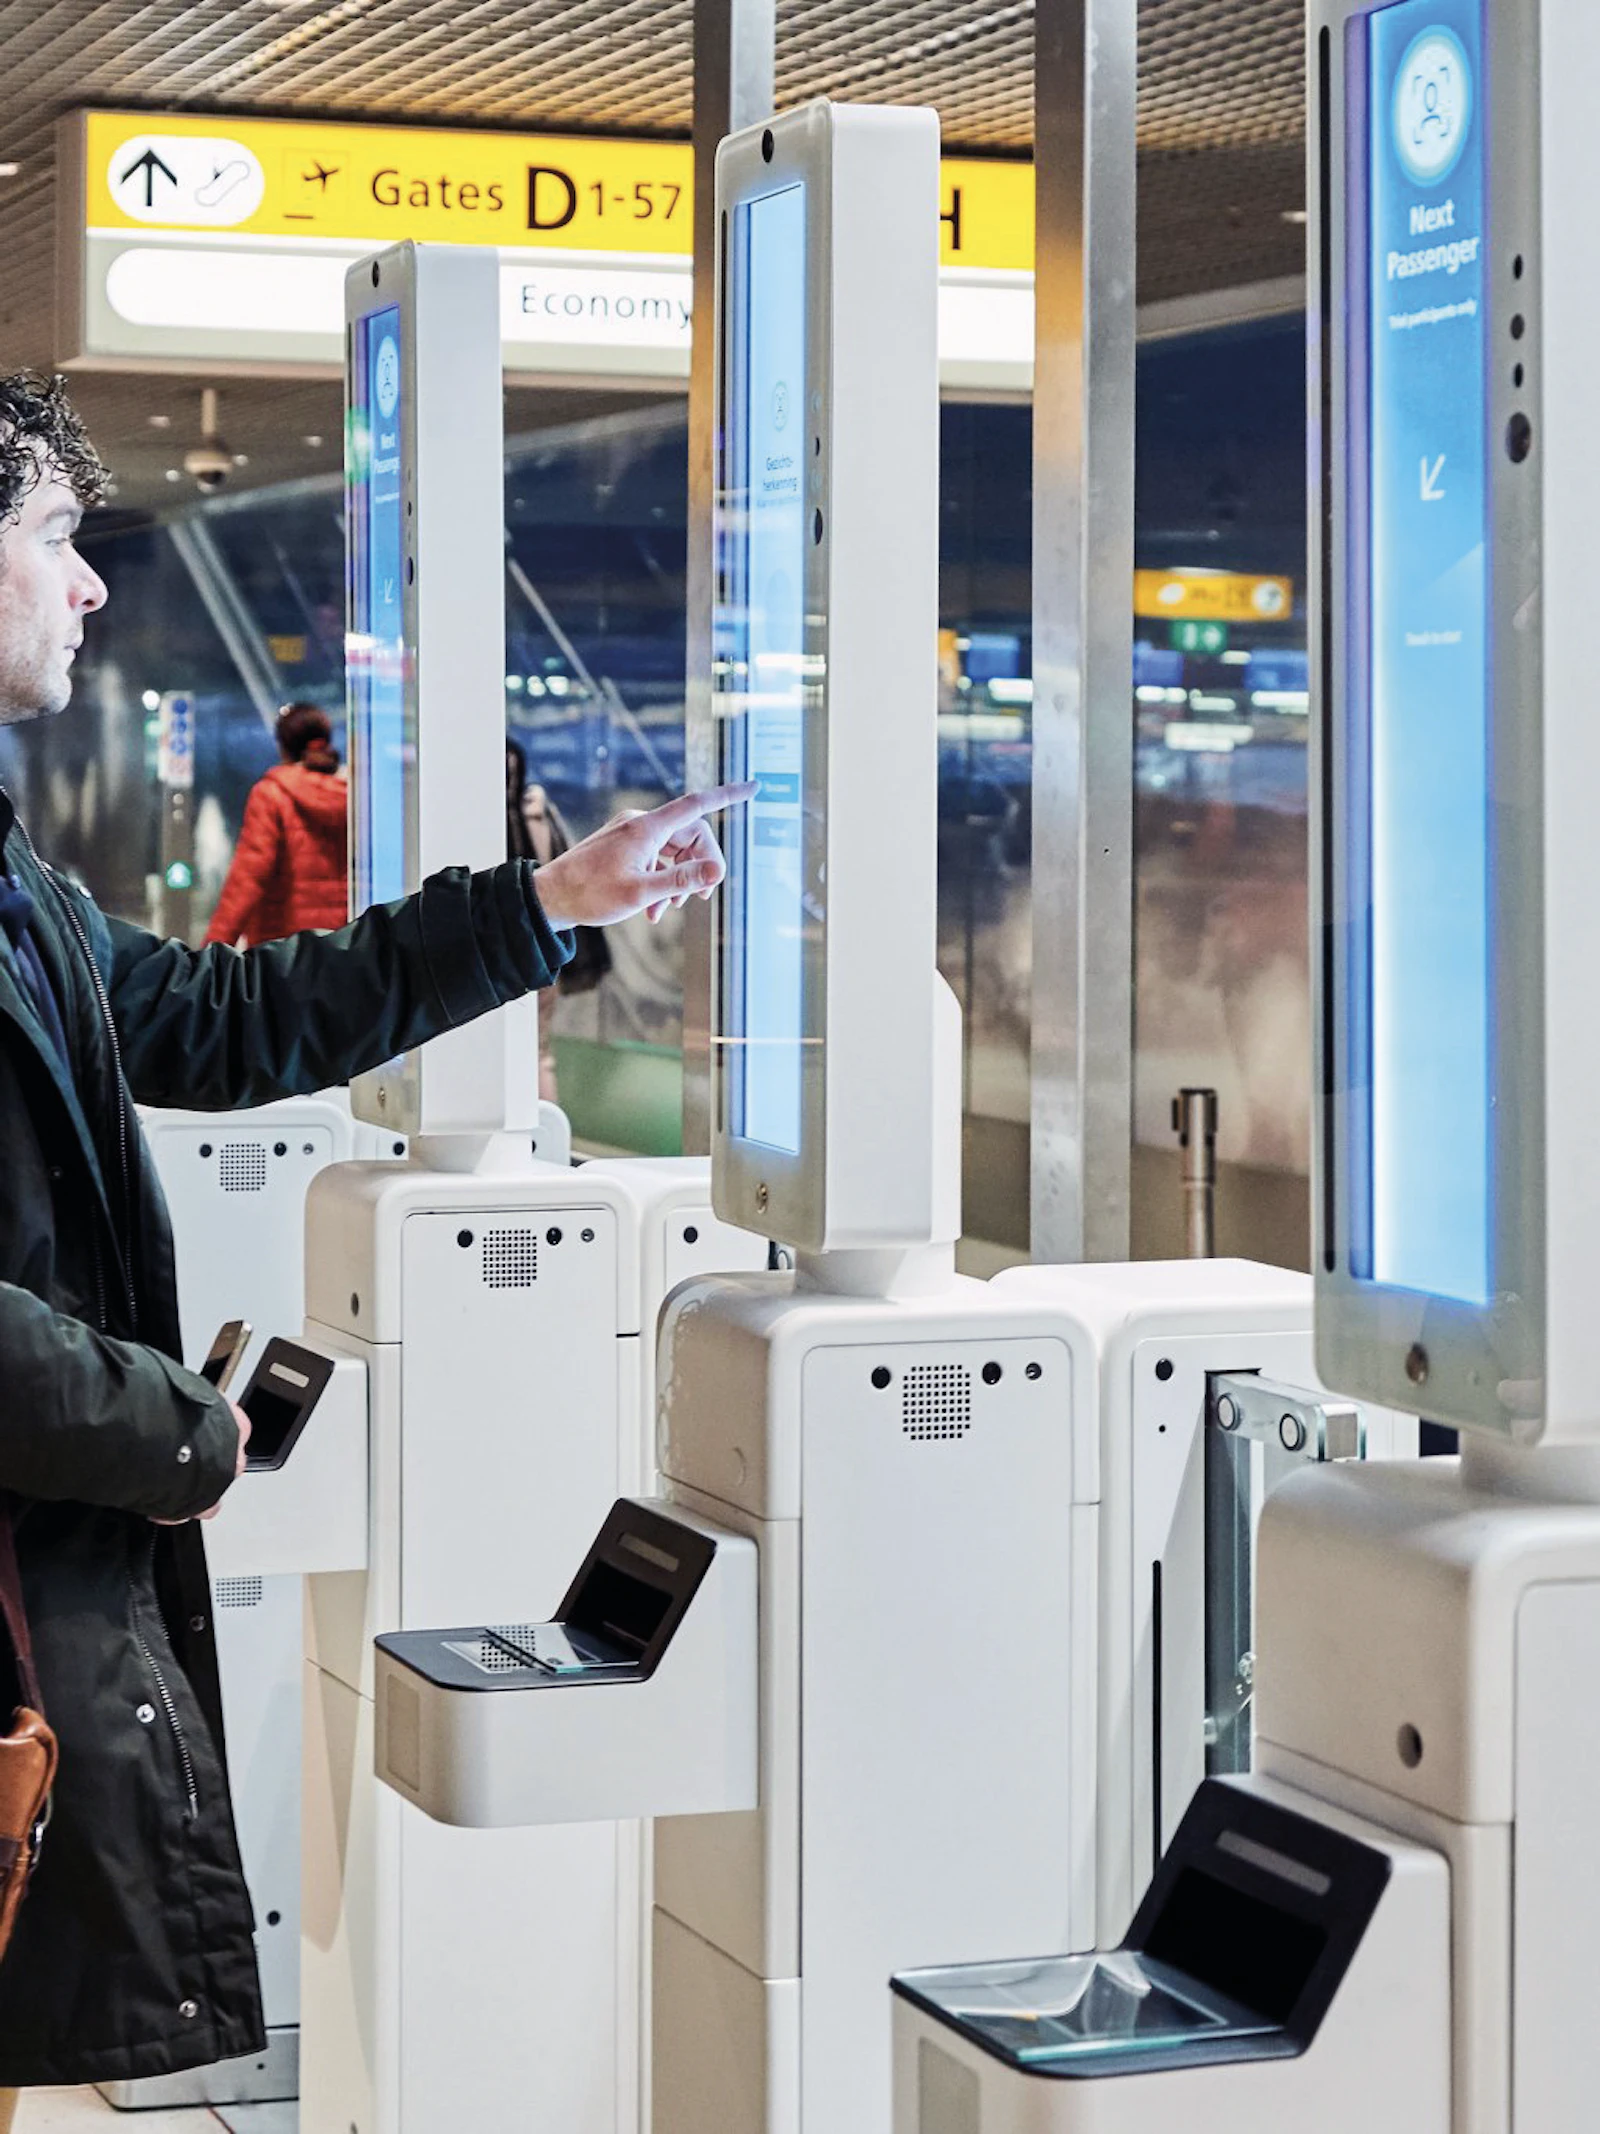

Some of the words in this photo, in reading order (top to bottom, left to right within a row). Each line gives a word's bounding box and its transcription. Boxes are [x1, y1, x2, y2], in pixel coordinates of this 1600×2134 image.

[371, 168, 504, 212] Gates
[527, 165, 578, 230] D
[589, 179, 682, 220] 1-57
[1409, 199, 1455, 236] Next
[1387, 237, 1480, 281] Passenger
[521, 284, 693, 329] Economy
